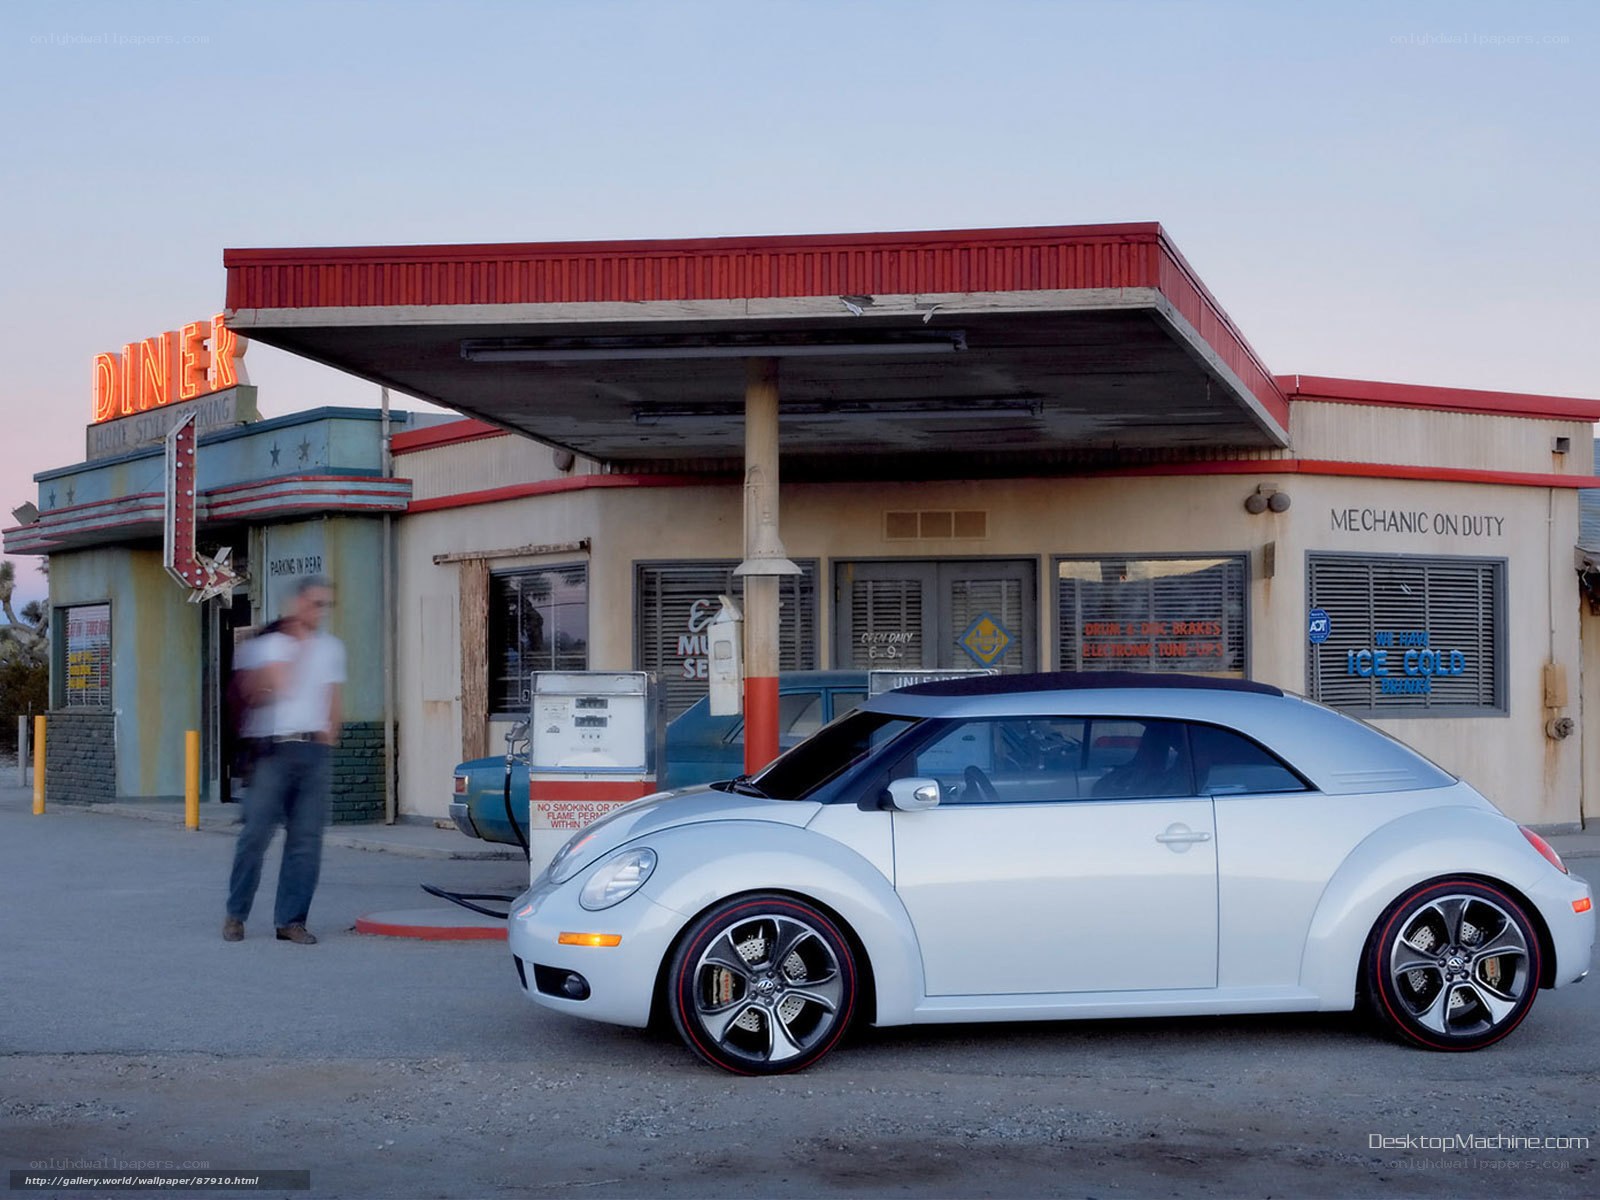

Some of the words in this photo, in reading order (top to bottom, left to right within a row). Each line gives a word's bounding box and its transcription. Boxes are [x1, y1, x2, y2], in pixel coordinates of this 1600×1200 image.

[92, 312, 240, 424] DINER
[96, 422, 127, 453] HOME
[136, 414, 167, 444] STYLE
[1331, 508, 1429, 534] MECHANIC
[1433, 513, 1459, 536] ON
[1463, 515, 1505, 537] DUTY
[270, 558, 295, 577] PARKING
[296, 557, 304, 574] IN
[1085, 622, 1121, 636] DRUM
[1172, 621, 1221, 636] BRAKES
[1309, 619, 1327, 632] ADT
[862, 632, 888, 643] OPEN
[888, 632, 913, 643] DAILY
[1375, 631, 1394, 647] WE
[1400, 630, 1429, 647] HAVE
[1082, 643, 1153, 657] ELECTRONIC
[1157, 642, 1224, 657] TUNE-UPS
[1347, 649, 1389, 677] ICE
[1404, 649, 1466, 676] COLD
[1381, 677, 1432, 694] DRINKS
[537, 803, 551, 812] NO
[553, 803, 594, 812] SMOKING
[596, 803, 610, 812] OR
[547, 812, 574, 820] FLAME
[551, 820, 580, 828] WITHIN
